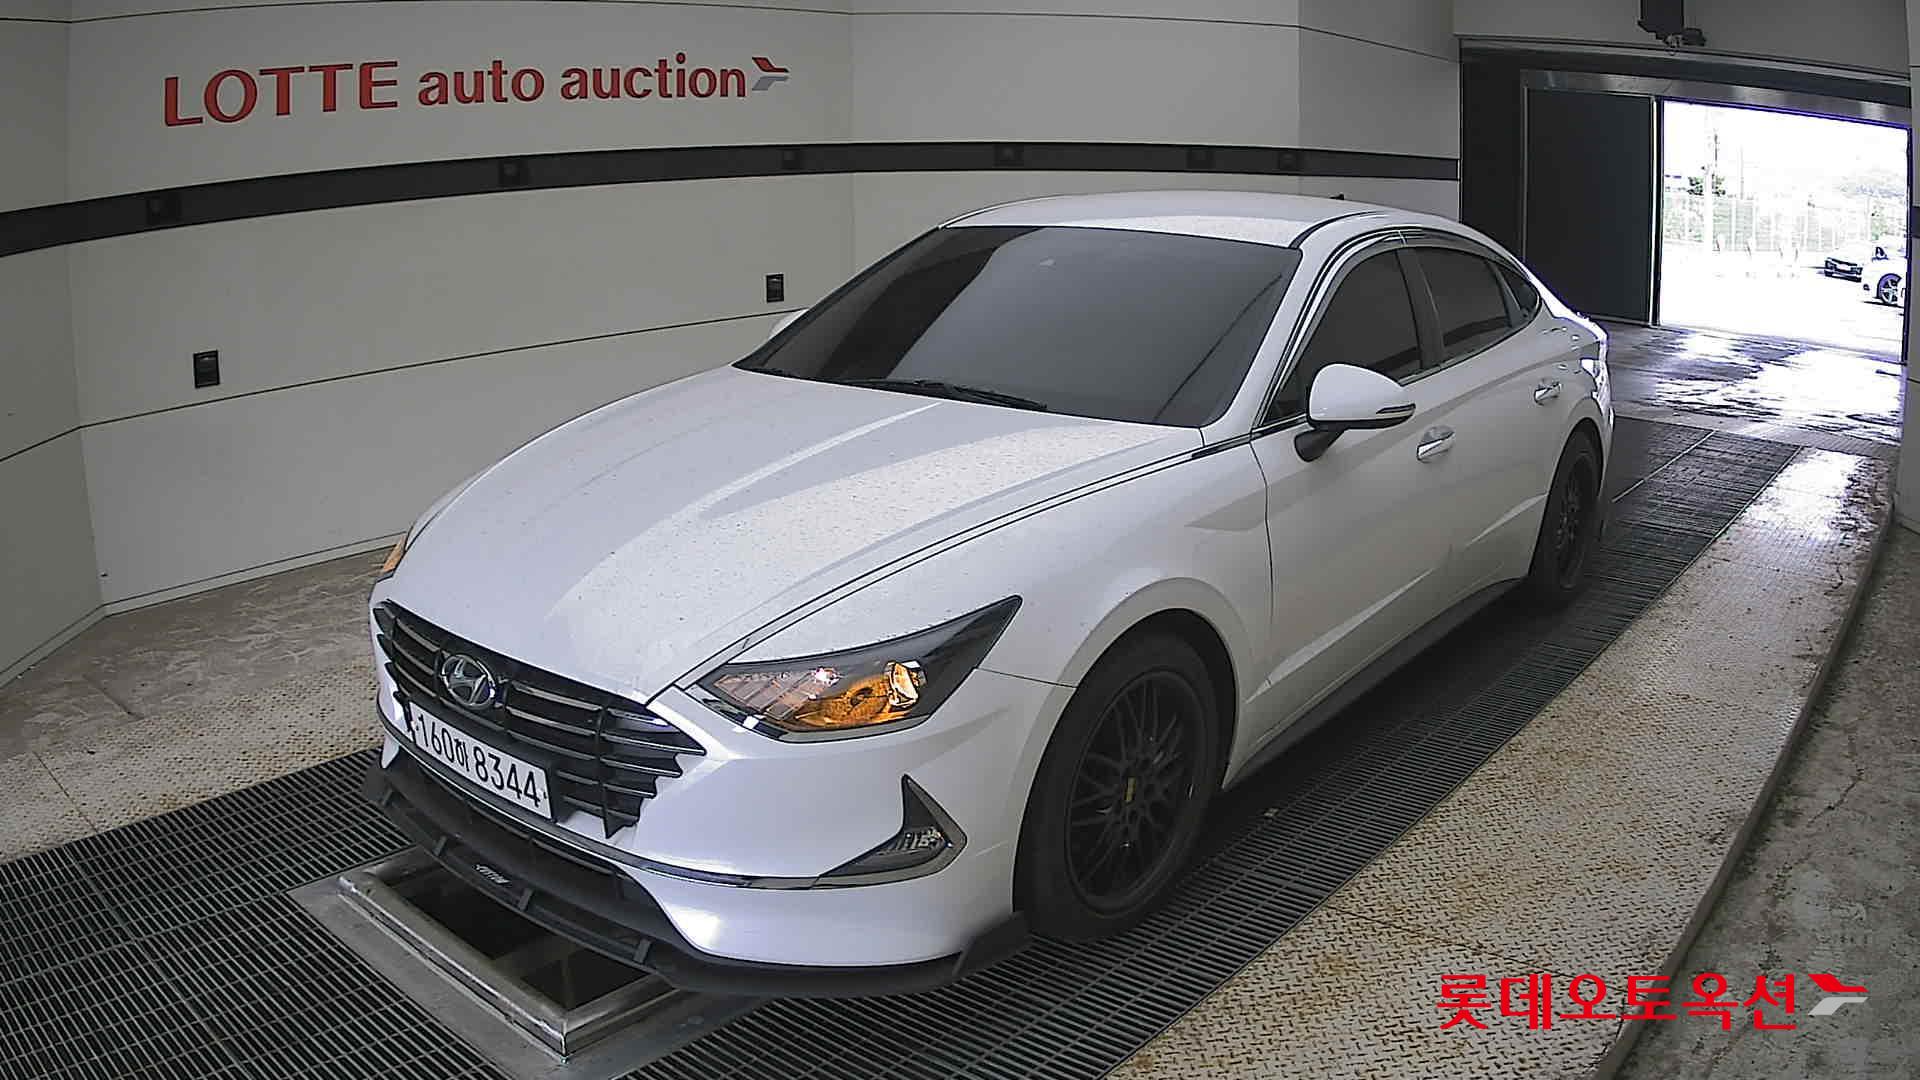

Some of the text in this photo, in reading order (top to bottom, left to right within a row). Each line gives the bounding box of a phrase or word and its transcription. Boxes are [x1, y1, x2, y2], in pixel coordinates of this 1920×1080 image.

[165, 52, 748, 127] LOTTE auto auction
